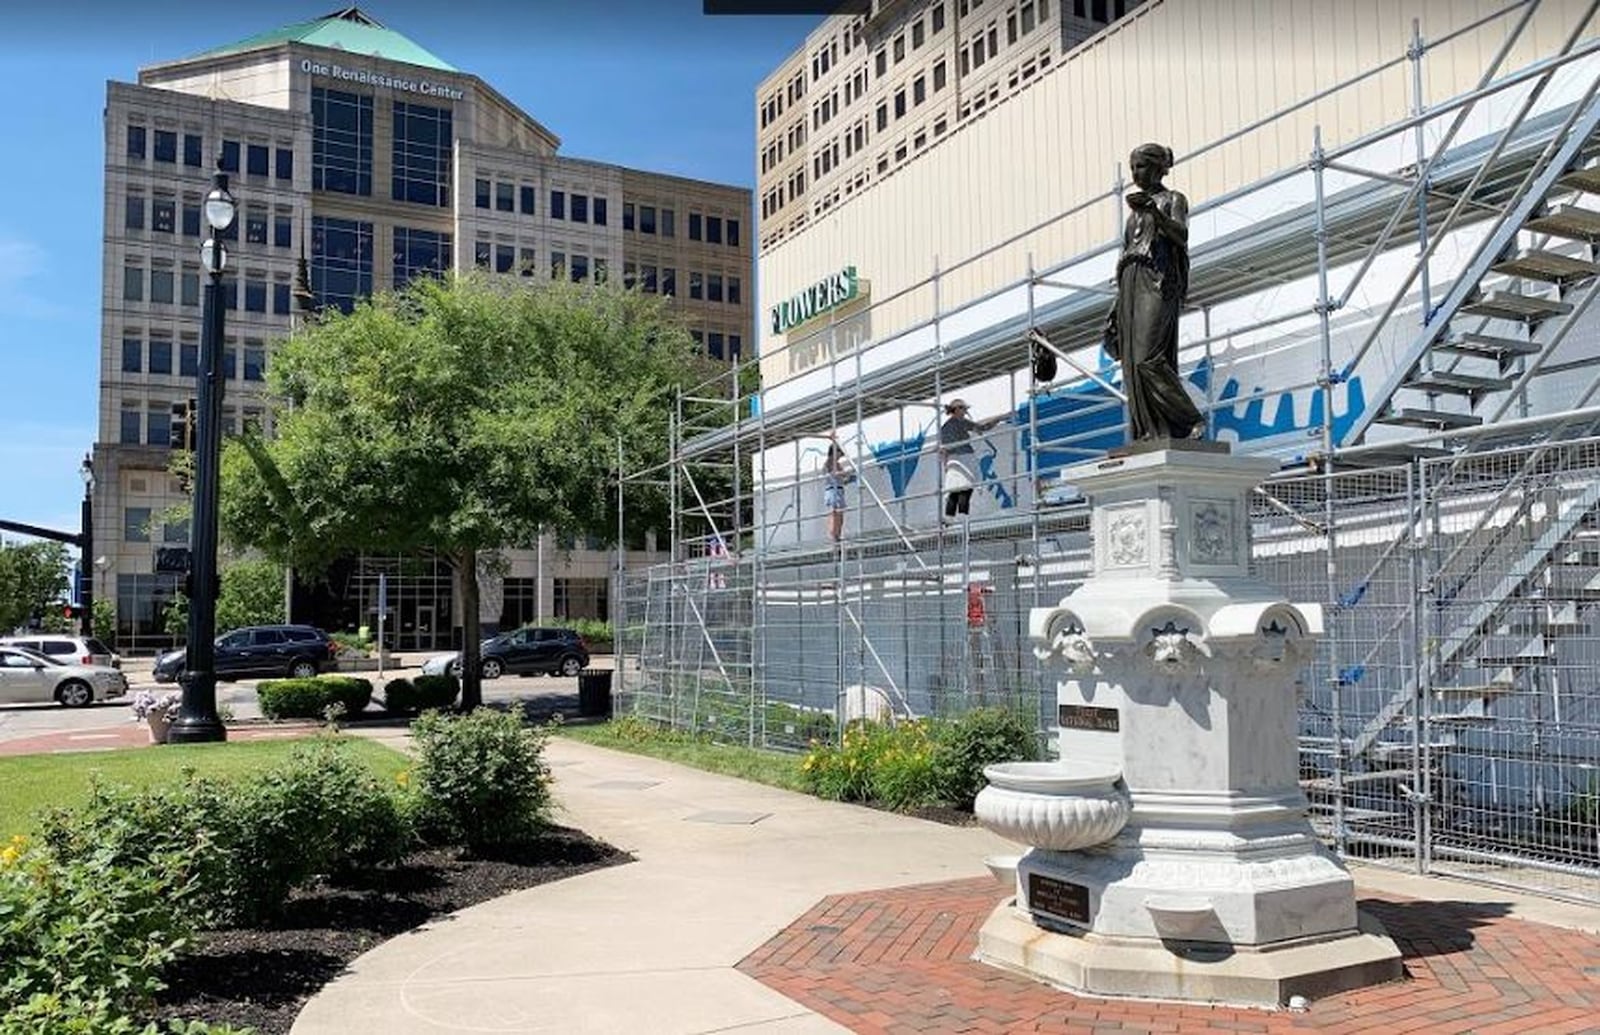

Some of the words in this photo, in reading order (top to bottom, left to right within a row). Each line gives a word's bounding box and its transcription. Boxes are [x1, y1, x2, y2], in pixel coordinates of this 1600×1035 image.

[301, 59, 329, 75] One
[332, 65, 417, 92] Renaissance
[420, 80, 464, 100] Center
[770, 265, 857, 336] FLOWERS
